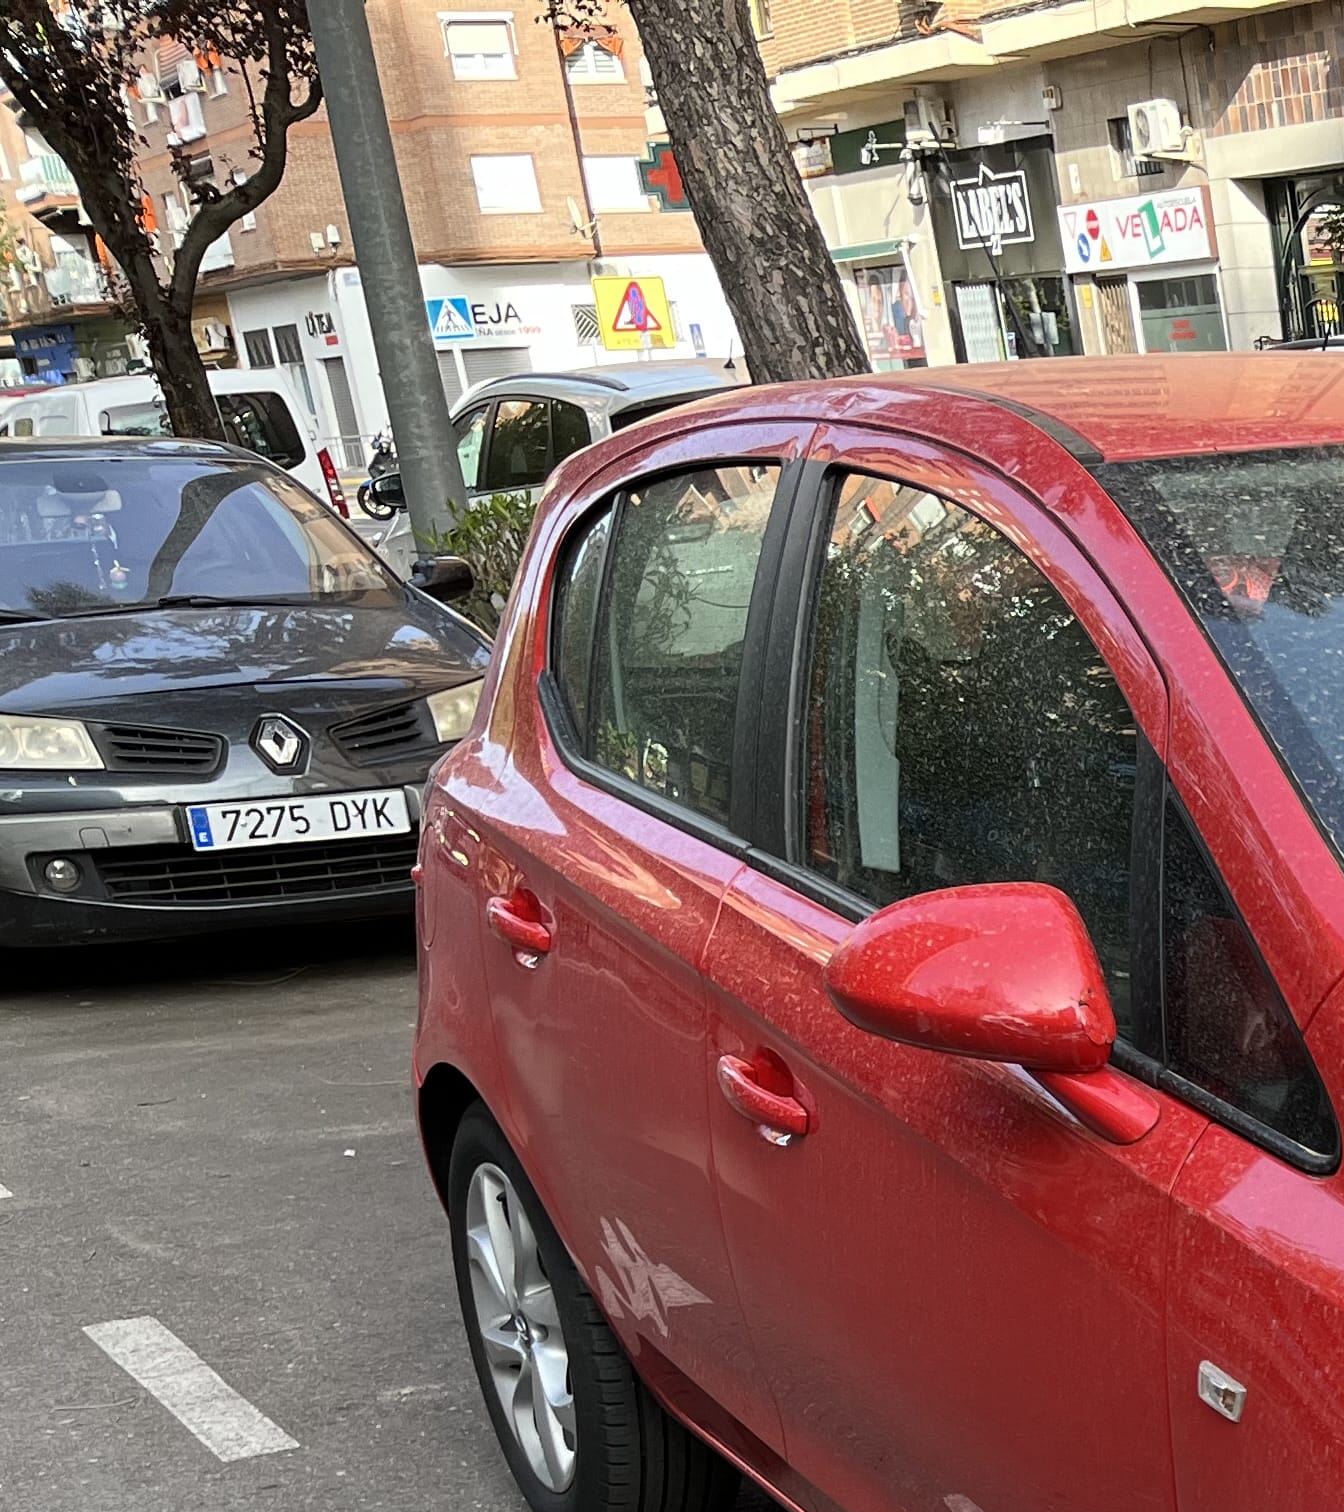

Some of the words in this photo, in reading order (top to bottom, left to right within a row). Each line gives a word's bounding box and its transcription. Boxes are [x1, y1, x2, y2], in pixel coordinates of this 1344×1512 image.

[471, 302, 522, 325] EJA
[221, 804, 311, 842] 7275
[328, 797, 395, 832] DYK
[199, 831, 209, 843] E
